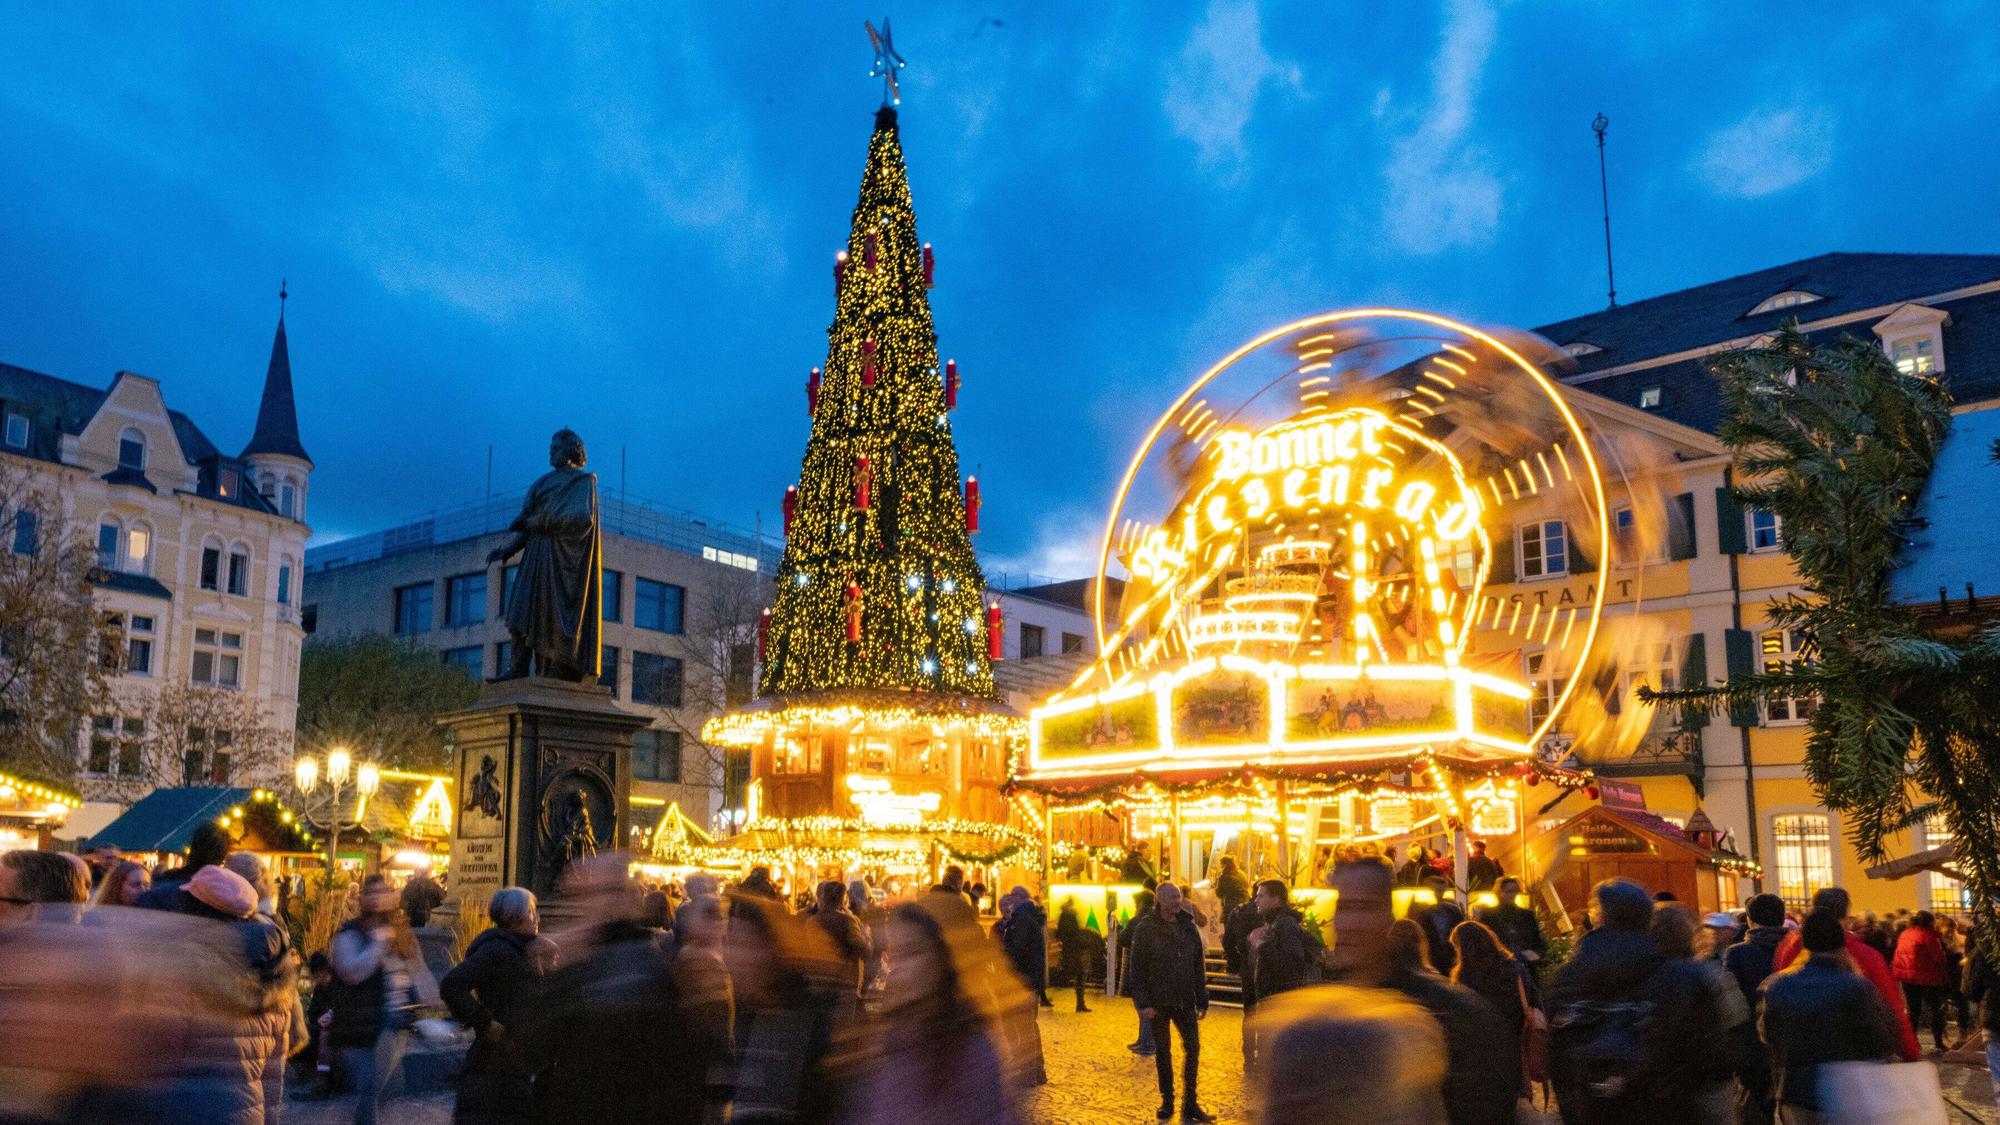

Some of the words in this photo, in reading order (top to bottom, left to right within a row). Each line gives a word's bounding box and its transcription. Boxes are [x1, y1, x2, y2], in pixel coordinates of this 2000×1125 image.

[1213, 414, 1389, 480] Bonner
[1131, 464, 1482, 586] Riesenrad
[1483, 578, 1633, 613] OSTAMT
[1570, 836, 1627, 846] aronen
